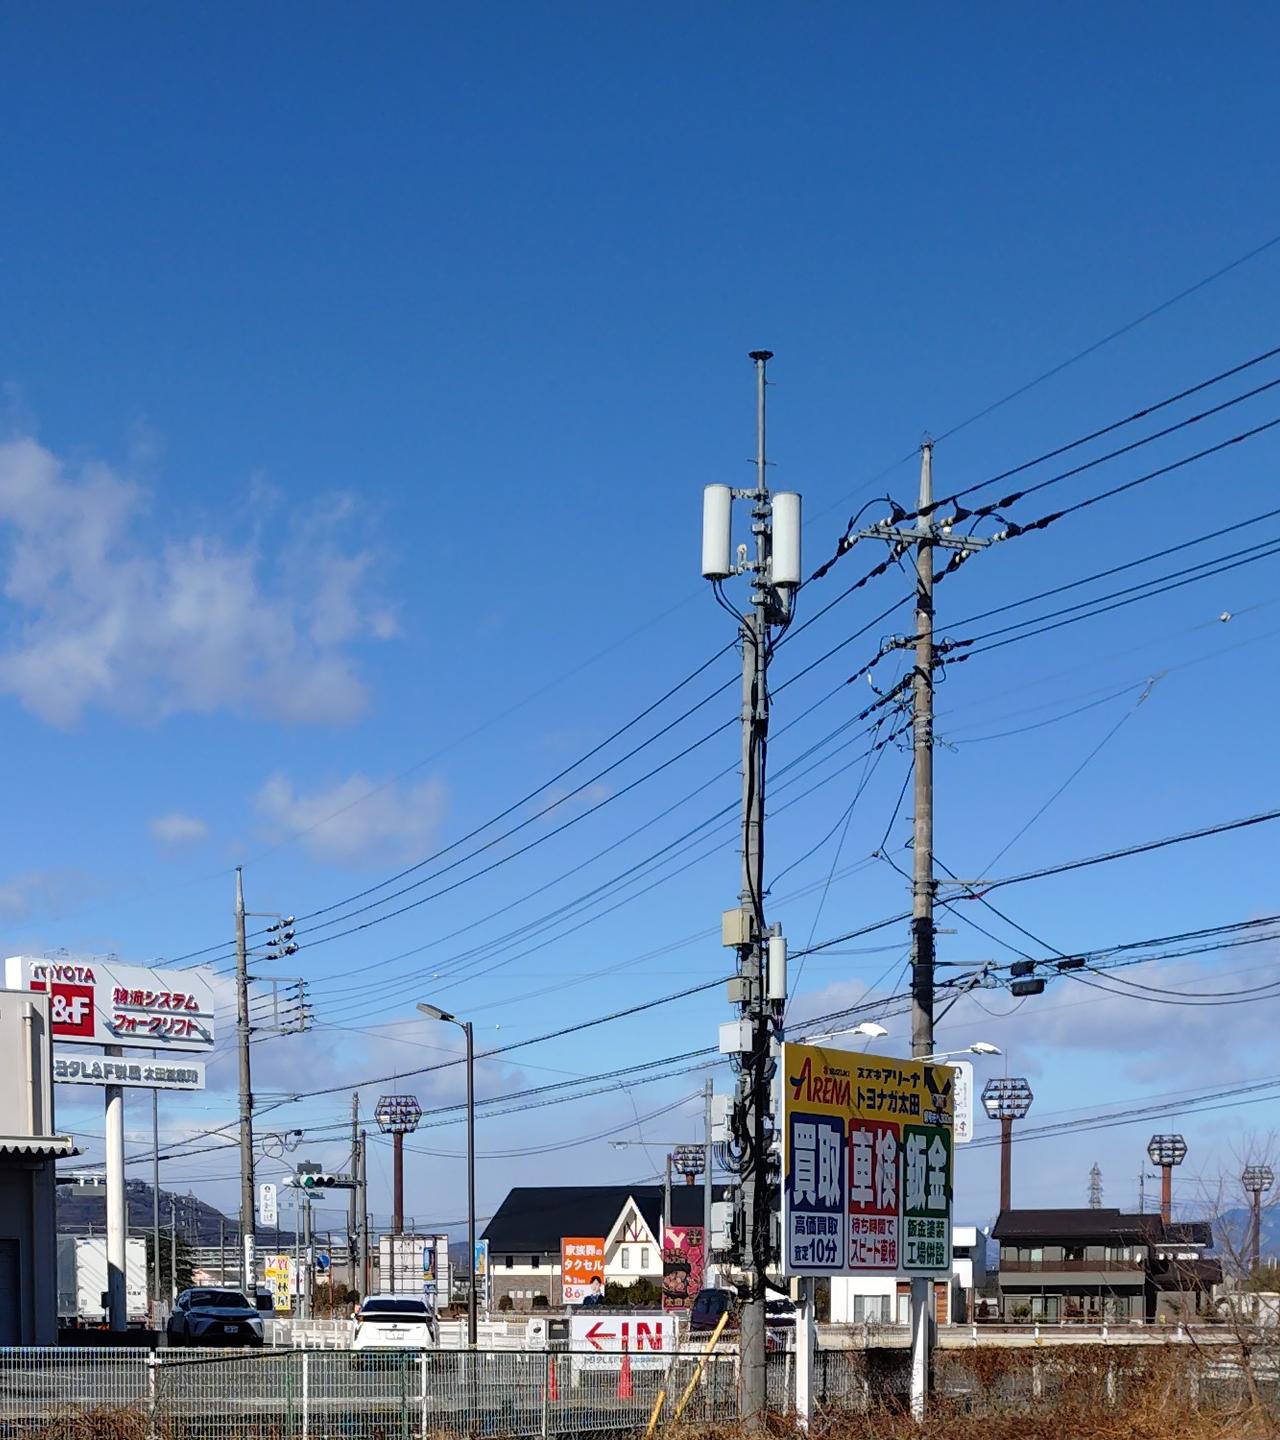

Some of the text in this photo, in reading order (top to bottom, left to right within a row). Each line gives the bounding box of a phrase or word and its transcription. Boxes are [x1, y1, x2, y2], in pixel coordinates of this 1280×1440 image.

[30, 962, 96, 984] TOYOTA
[52, 994, 90, 1025] &F
[113, 987, 200, 1012] 物流システム
[114, 1013, 198, 1037] フォークリフト
[53, 1060, 141, 1081] ヨタL&F群馬
[789, 1056, 851, 1107] ARENA
[857, 1067, 921, 1088] スズキアリーナ
[857, 1086, 920, 1116] トヨナガ太田
[793, 1122, 841, 1207] 買取
[851, 1126, 897, 1210] 車検
[906, 1132, 947, 1211] 鈑金
[794, 1215, 839, 1236] 高価買取
[851, 1216, 895, 1236] 待ち時間で
[907, 1219, 945, 1239] 鈑金塗装
[565, 1244, 603, 1257] 家族葬の
[794, 1238, 838, 1264] 査定10分
[851, 1237, 896, 1265] スピード車検
[564, 1258, 604, 1272] タクセル
[621, 1322, 663, 1351] IN
